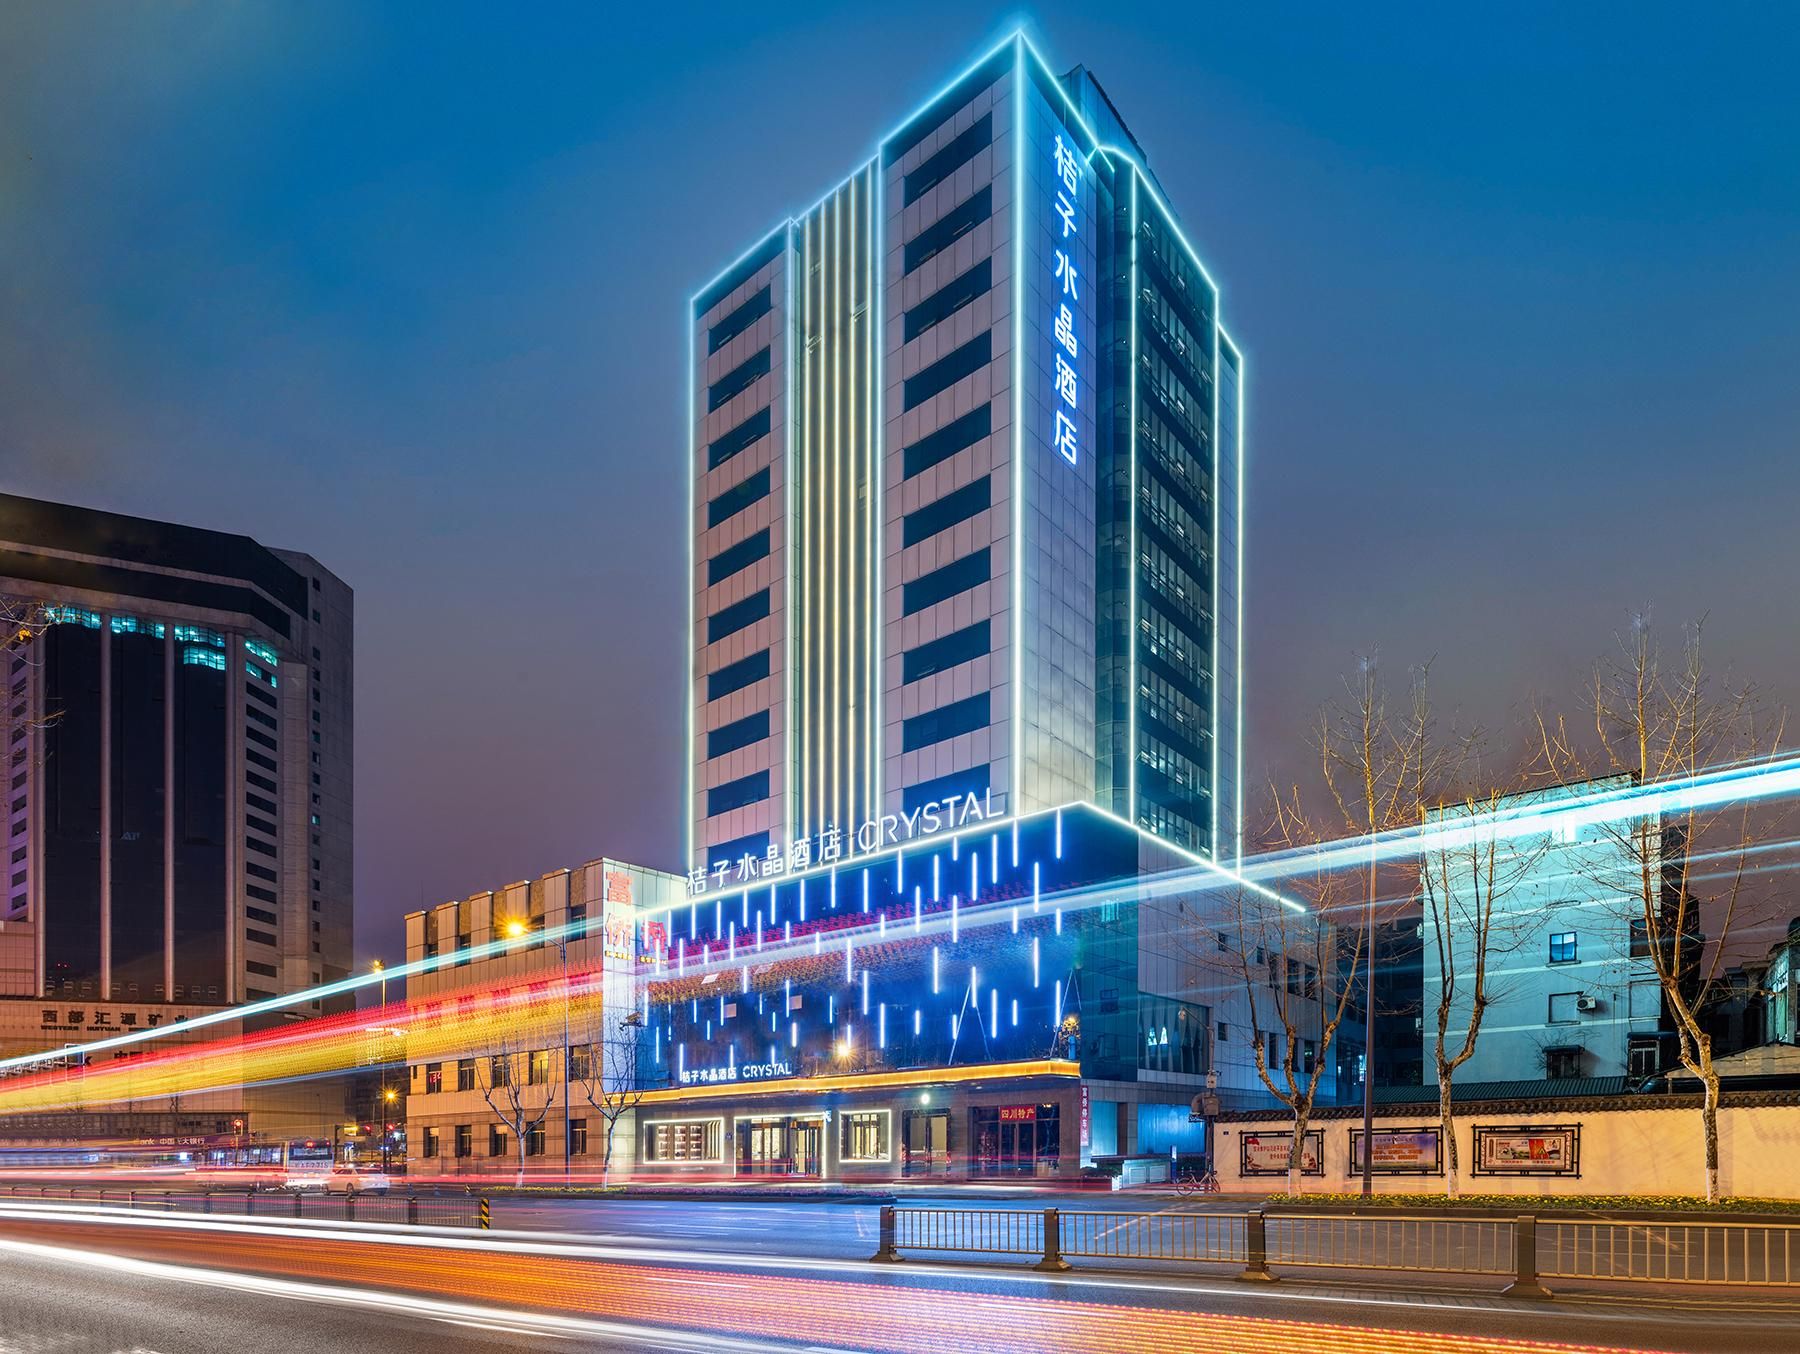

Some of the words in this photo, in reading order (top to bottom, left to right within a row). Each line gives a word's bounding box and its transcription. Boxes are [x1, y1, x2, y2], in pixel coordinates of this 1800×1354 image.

[1054, 135, 1077, 464] 桔子水晶酒店
[687, 824, 841, 893] 桔子水晶酒店
[858, 787, 1004, 852] CRYSTAL
[682, 1067, 737, 1083] 桔子水晶酒店
[743, 1062, 792, 1078] CRYSTAL
